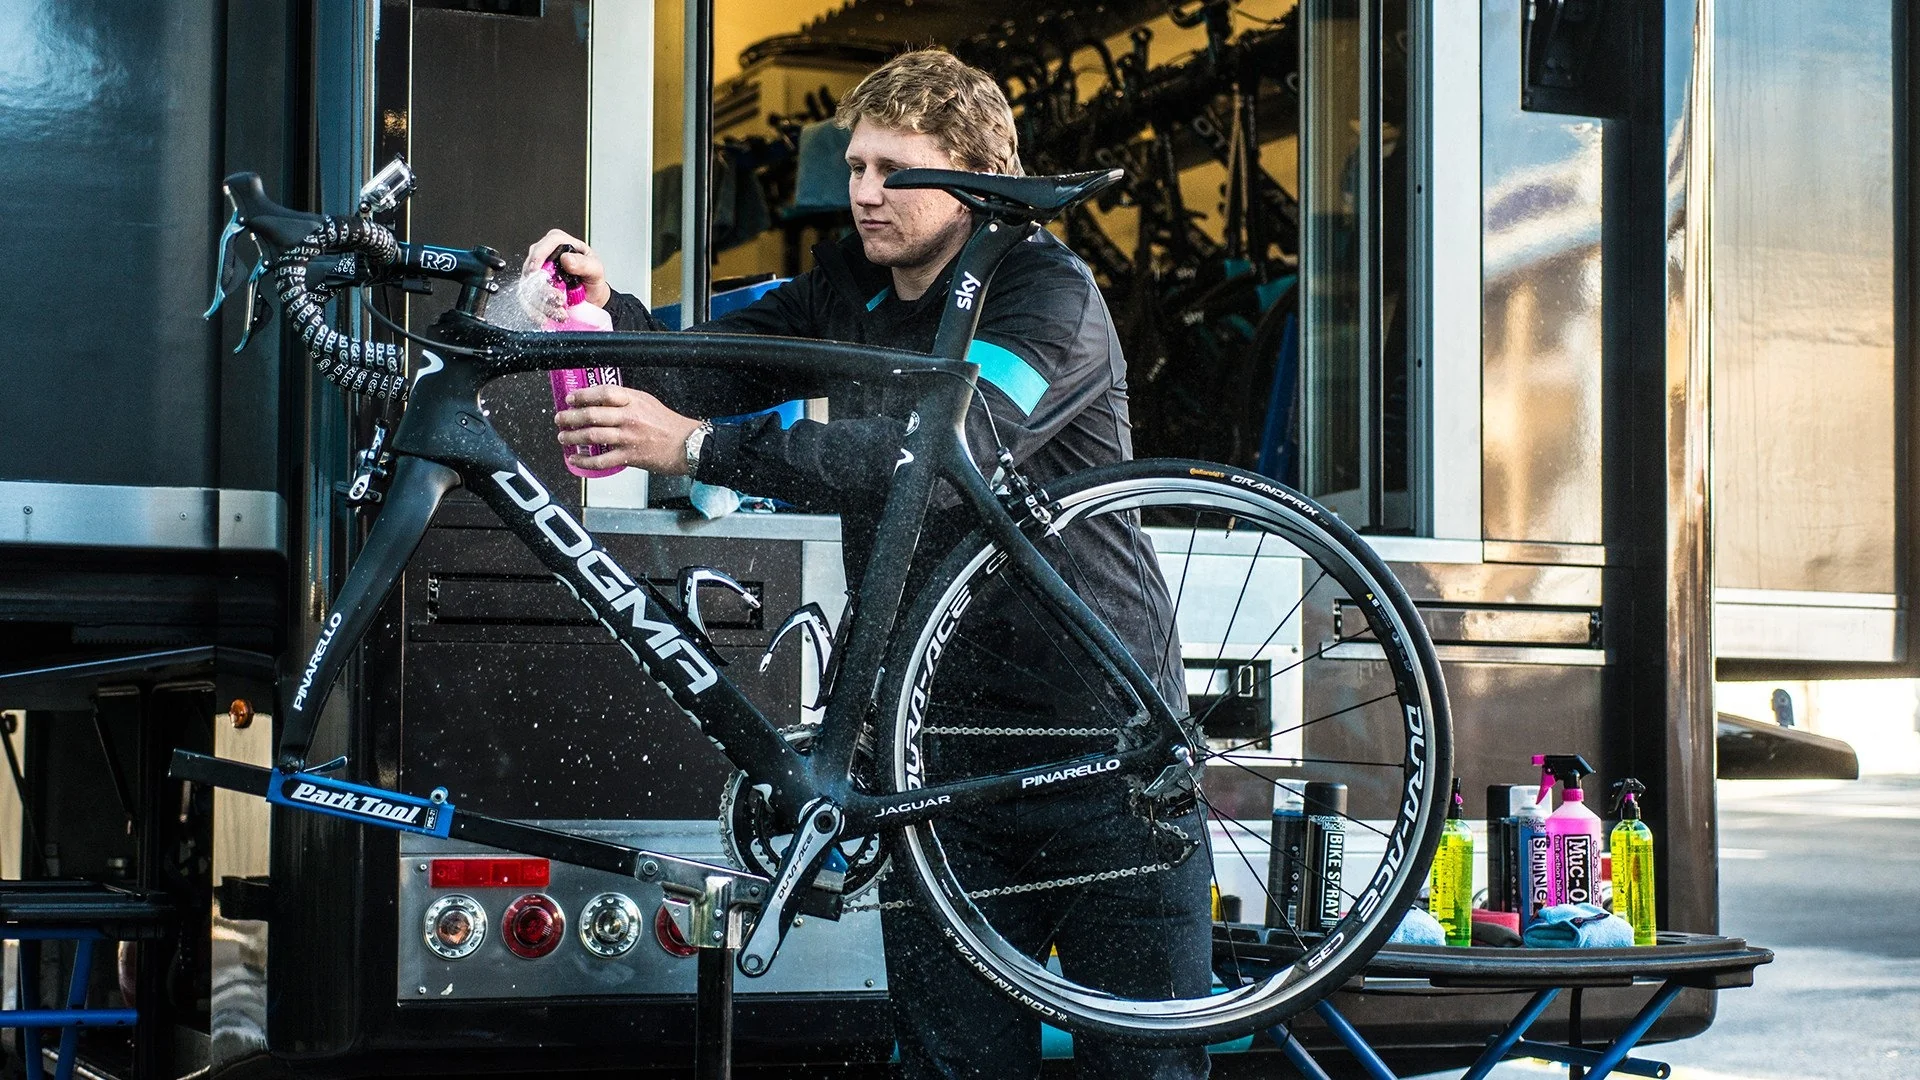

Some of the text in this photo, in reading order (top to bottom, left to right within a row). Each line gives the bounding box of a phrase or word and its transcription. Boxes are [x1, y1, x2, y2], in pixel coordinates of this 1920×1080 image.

[421, 250, 456, 271] RO
[955, 271, 981, 310] sky
[492, 461, 718, 695] DOGMA
[293, 612, 342, 711] PINARELLO
[1022, 759, 1120, 789] PINARELLO
[291, 782, 421, 823] Park Tool
[875, 795, 951, 817] JAGUAR
[1358, 704, 1424, 923] DURA-ACE
[778, 833, 813, 899] DURA-ACE
[1328, 834, 1343, 868] BIKE
[1555, 853, 1563, 878] action
[1569, 840, 1588, 904] Muc-O
[1325, 871, 1341, 920] SPRAY
[954, 936, 1056, 1016] CONTINENTAL
